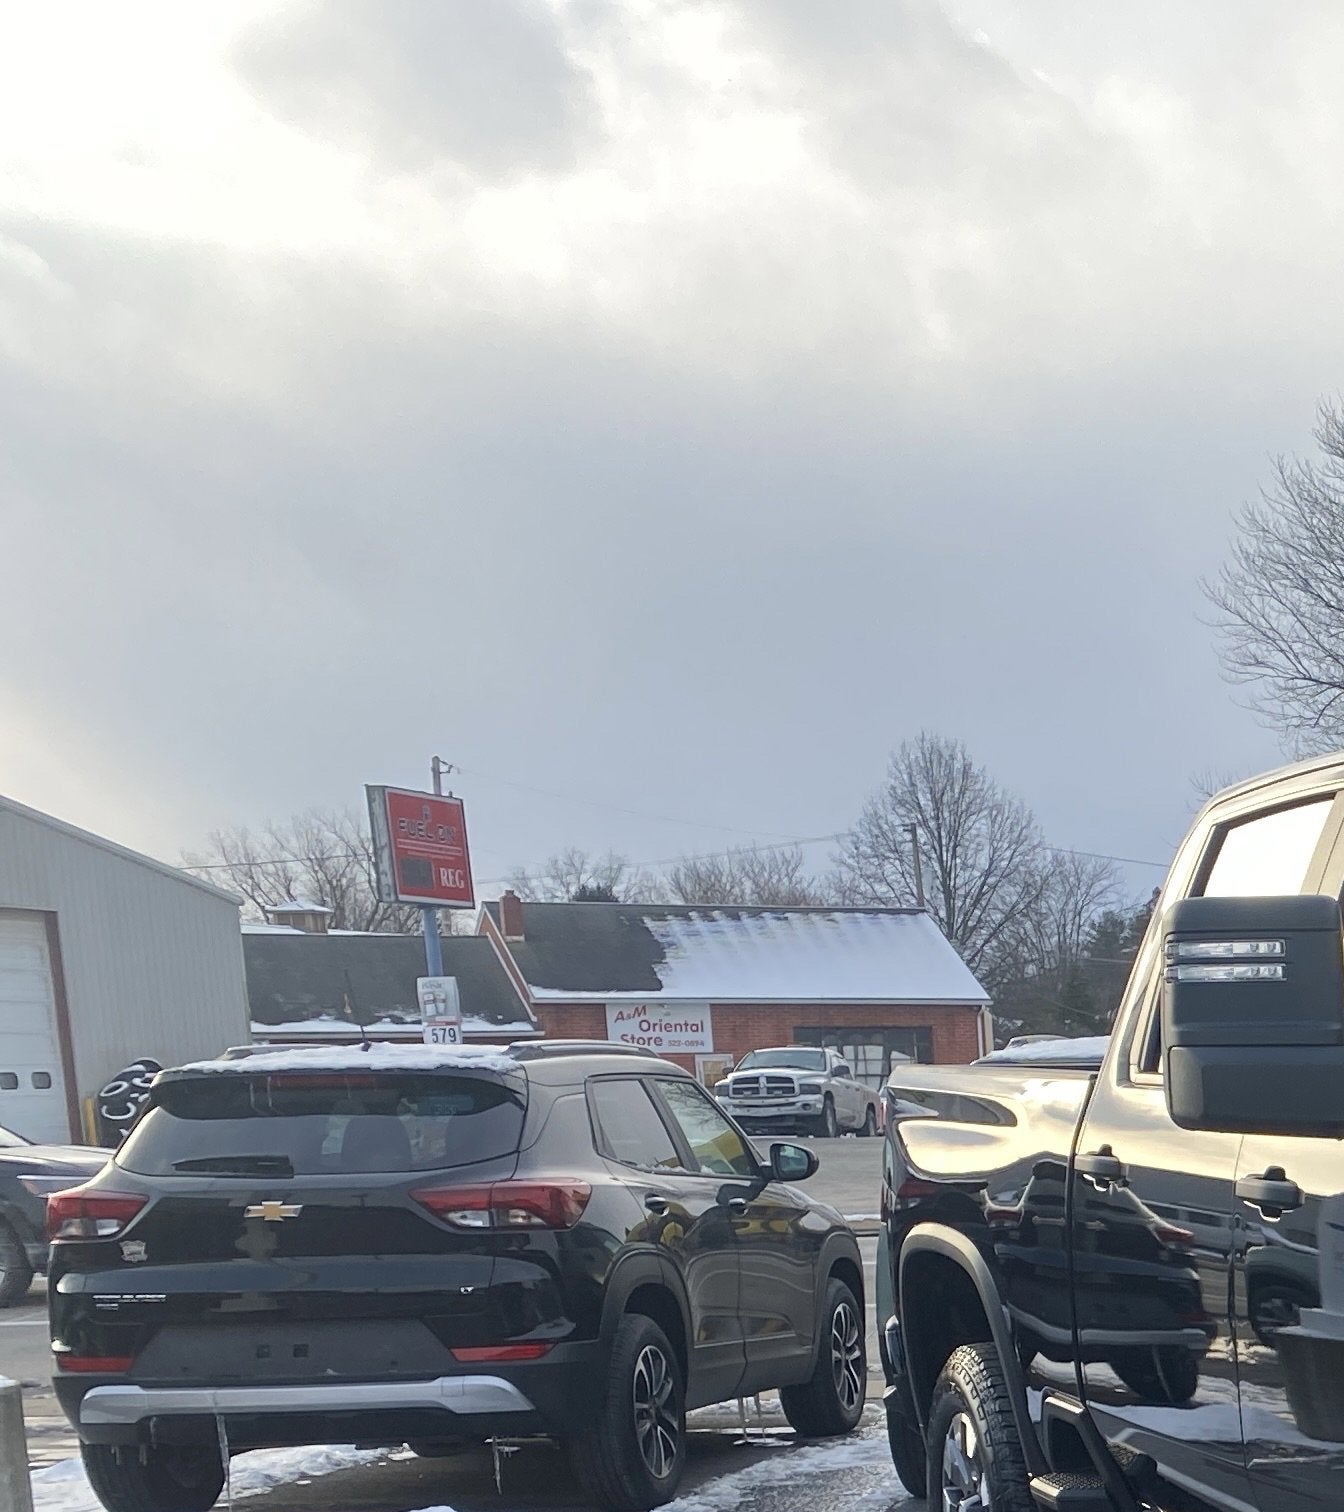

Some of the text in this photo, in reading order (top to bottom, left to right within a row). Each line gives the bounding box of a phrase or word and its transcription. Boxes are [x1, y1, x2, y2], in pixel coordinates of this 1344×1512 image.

[398, 817, 434, 840] FUEL
[440, 867, 465, 889] REG
[614, 1004, 648, 1024] A&M
[639, 1019, 704, 1033] Oriental
[431, 1027, 457, 1044] 579
[620, 1033, 663, 1047] Store
